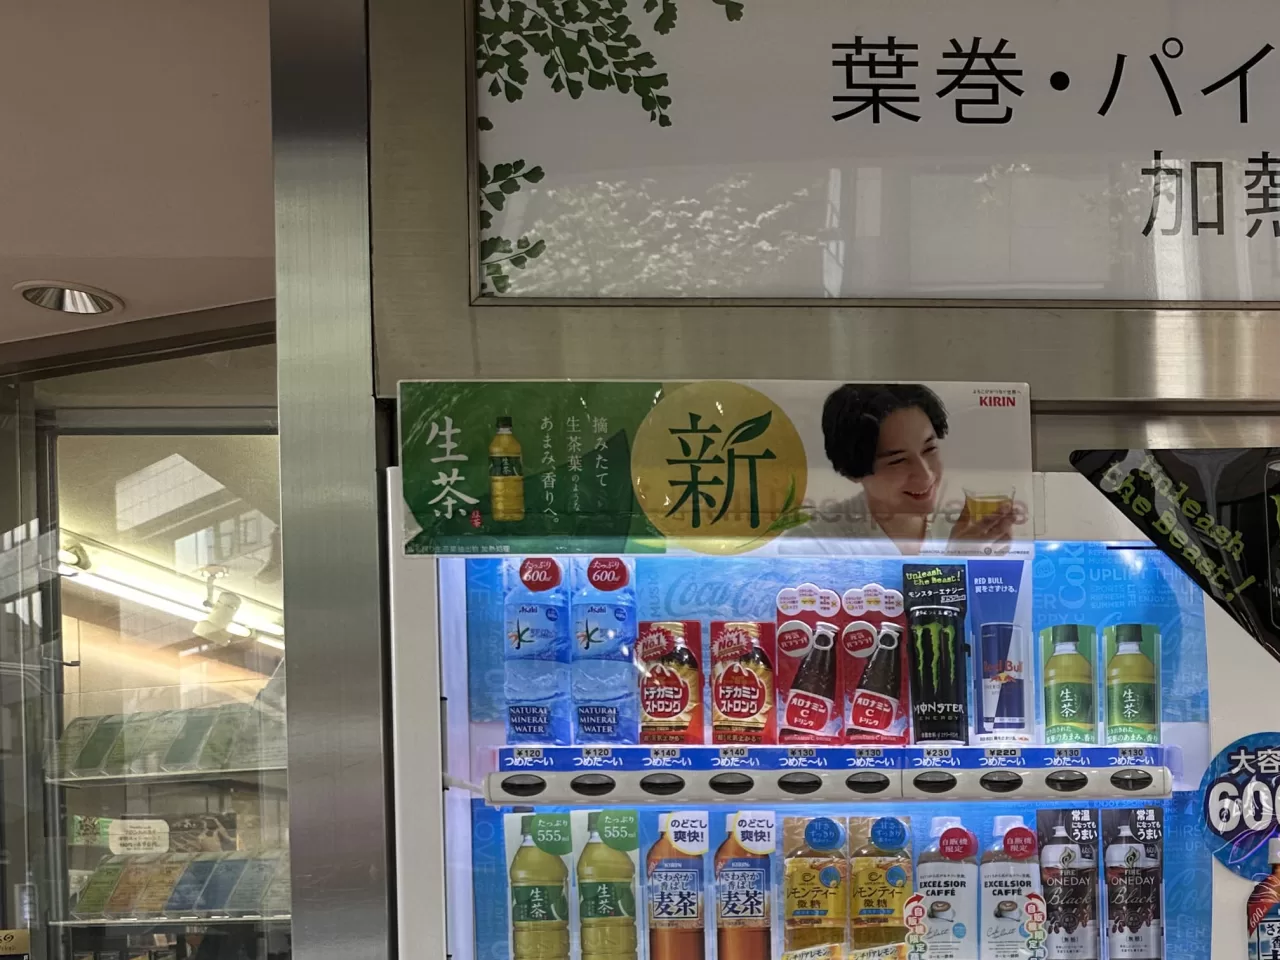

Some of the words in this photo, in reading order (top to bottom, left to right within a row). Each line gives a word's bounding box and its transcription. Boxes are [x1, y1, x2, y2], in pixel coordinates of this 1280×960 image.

[979, 396, 1015, 406] KIRIN
[592, 416, 608, 488] 摘みたて
[426, 417, 479, 519] 生茶
[540, 416, 560, 523] あまみ、香りへ。
[665, 410, 777, 528] 新
[906, 568, 942, 579] Unleash
[974, 577, 986, 585] RED
[988, 577, 1003, 585] BULL
[510, 706, 548, 715] NATURAL
[646, 700, 681, 713] ストロング
[511, 715, 548, 724] MINERAL
[515, 725, 544, 733] WATER
[516, 749, 541, 757] ¥120
[585, 748, 609, 757] ¥120
[653, 749, 677, 757] ¥140
[723, 748, 745, 757] ¥140
[790, 749, 814, 757] ¥130
[857, 749, 881, 757] ¥130
[926, 749, 949, 757] ¥230
[1071, 810, 1092, 821] 常温
[670, 818, 707, 830] のどごし
[737, 818, 774, 830] のどごし
[1071, 820, 1097, 829] になっても
[673, 829, 705, 843] 爽快!
[1072, 828, 1098, 840] うまい
[1137, 828, 1163, 840] うまい
[1111, 876, 1154, 886] ONEDAY
[653, 892, 697, 917] 麦茶
[720, 892, 764, 917] 麦茶
